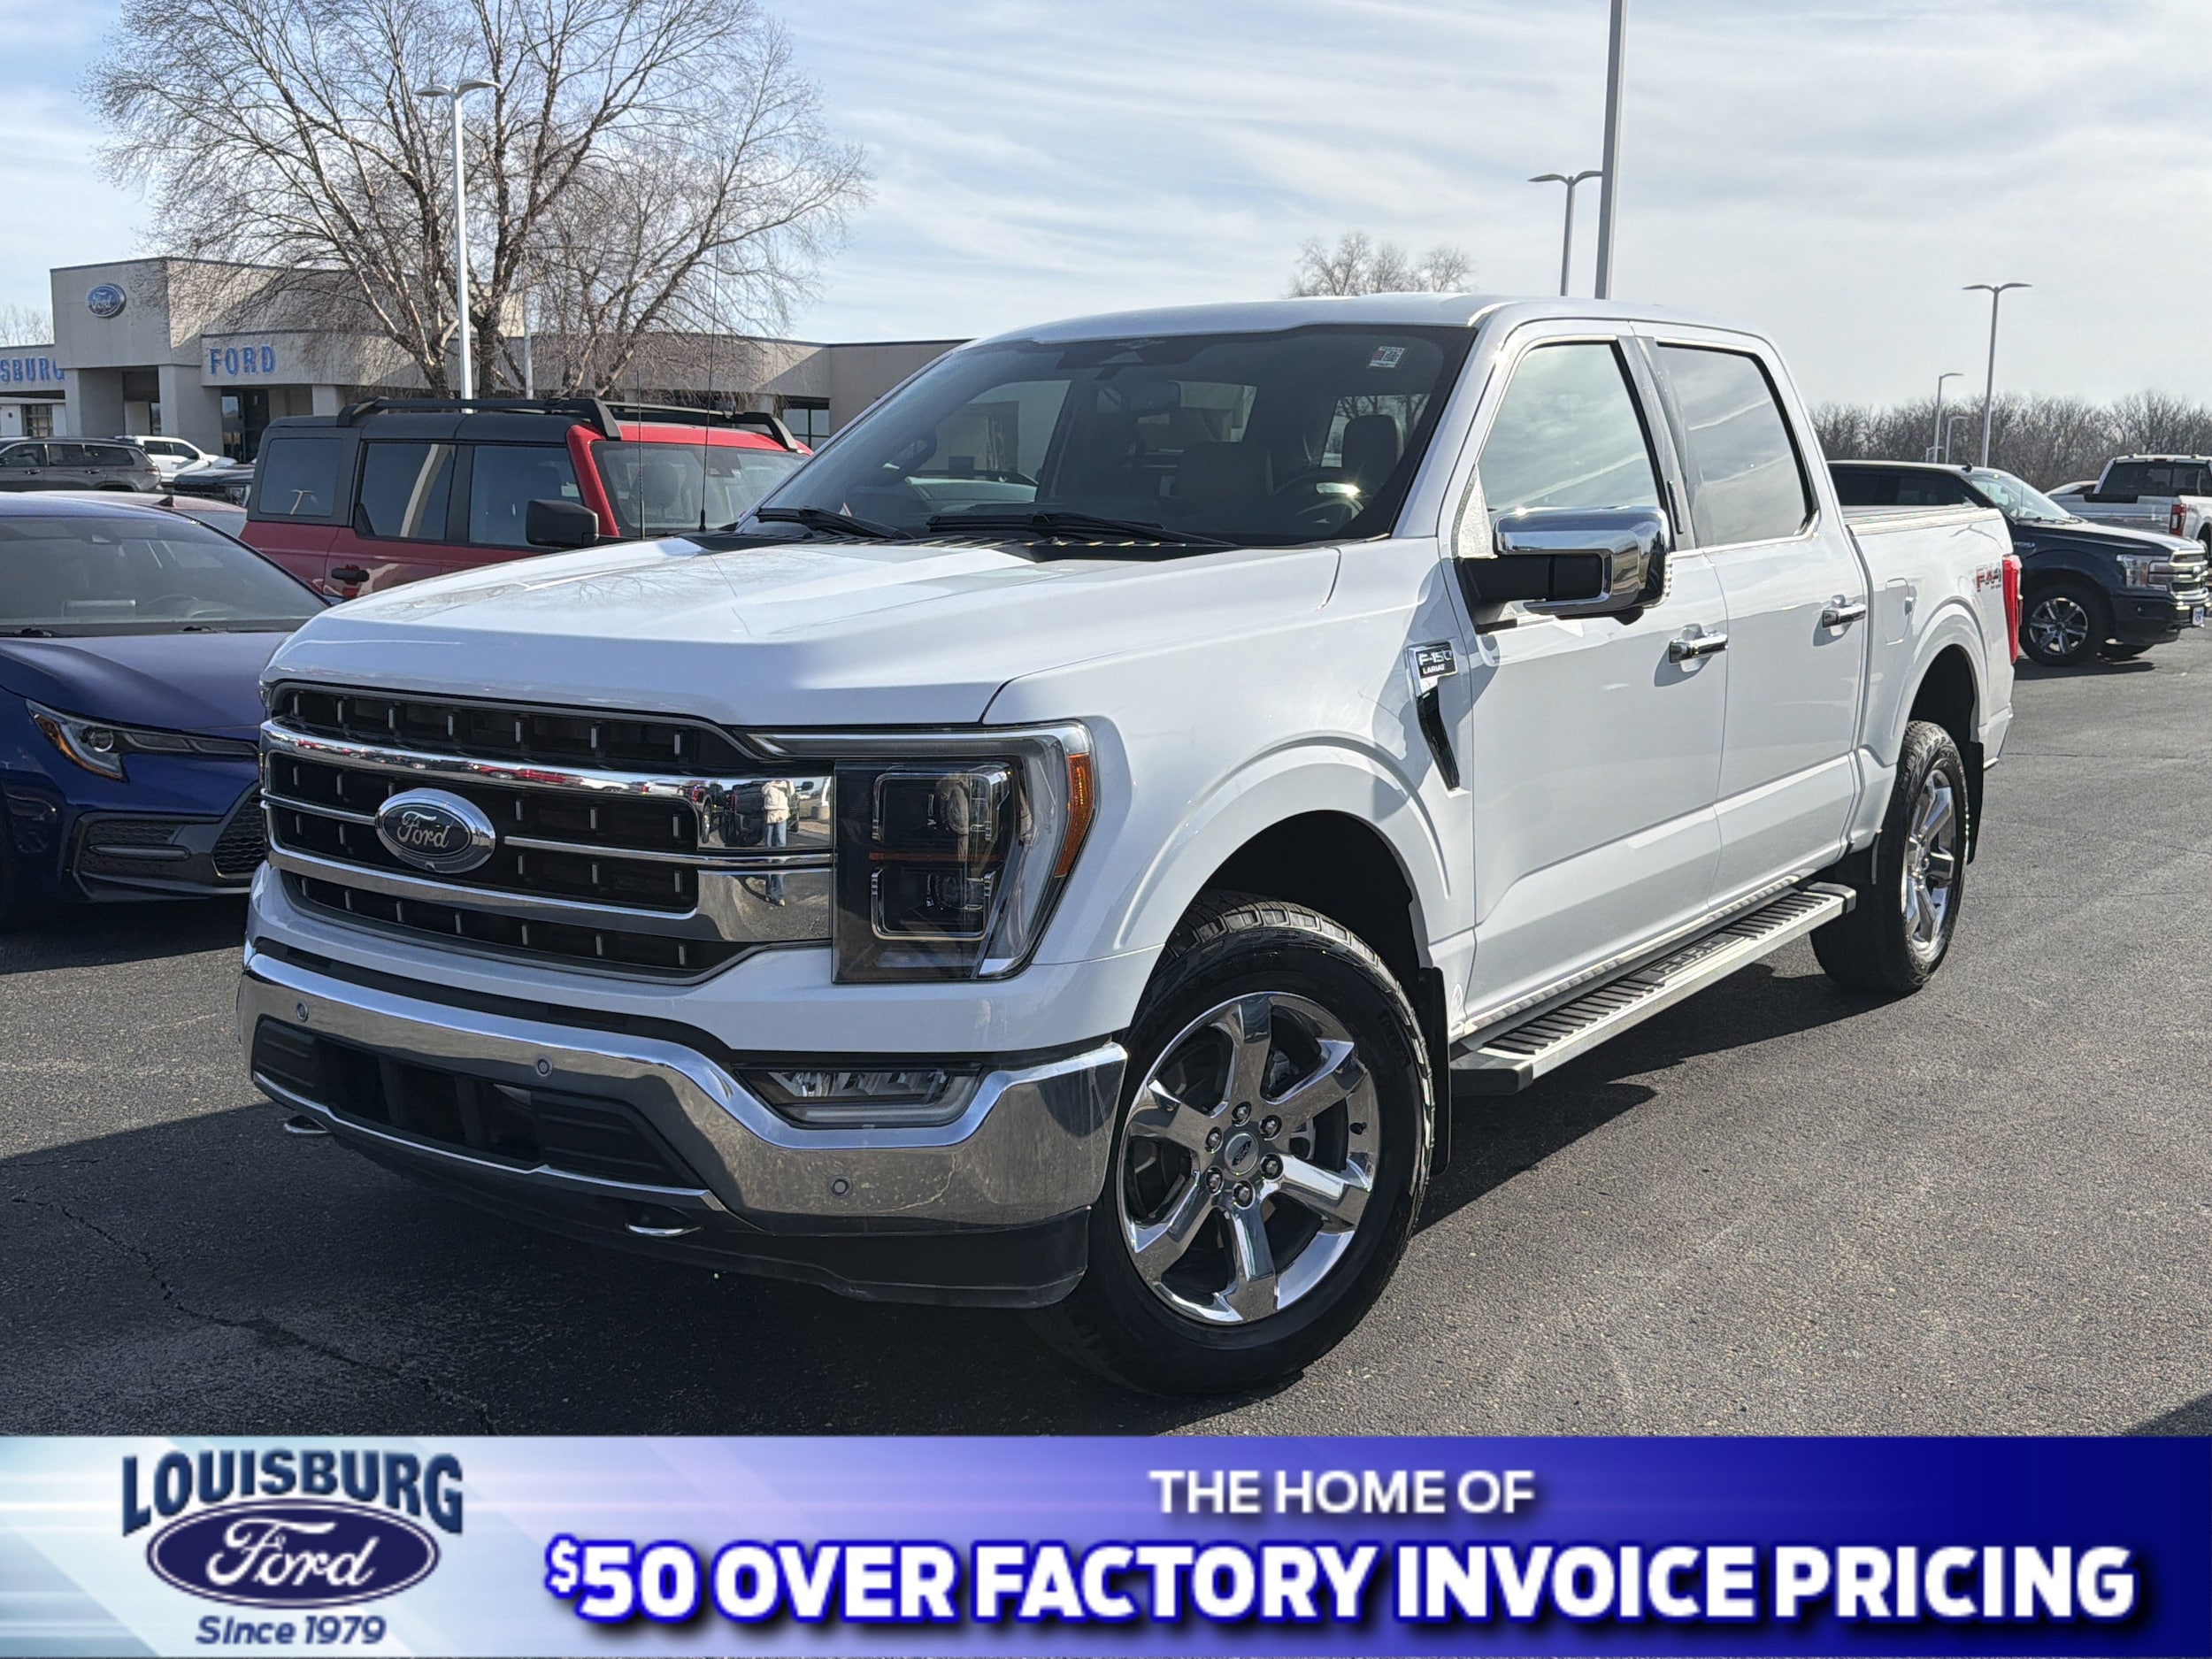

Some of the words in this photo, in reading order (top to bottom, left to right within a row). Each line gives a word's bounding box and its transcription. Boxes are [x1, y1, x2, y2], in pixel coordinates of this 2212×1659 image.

[209, 344, 276, 377] FORD
[1417, 649, 1453, 666] F-150
[1422, 663, 1446, 675] LARIAT
[396, 810, 450, 849] Ford
